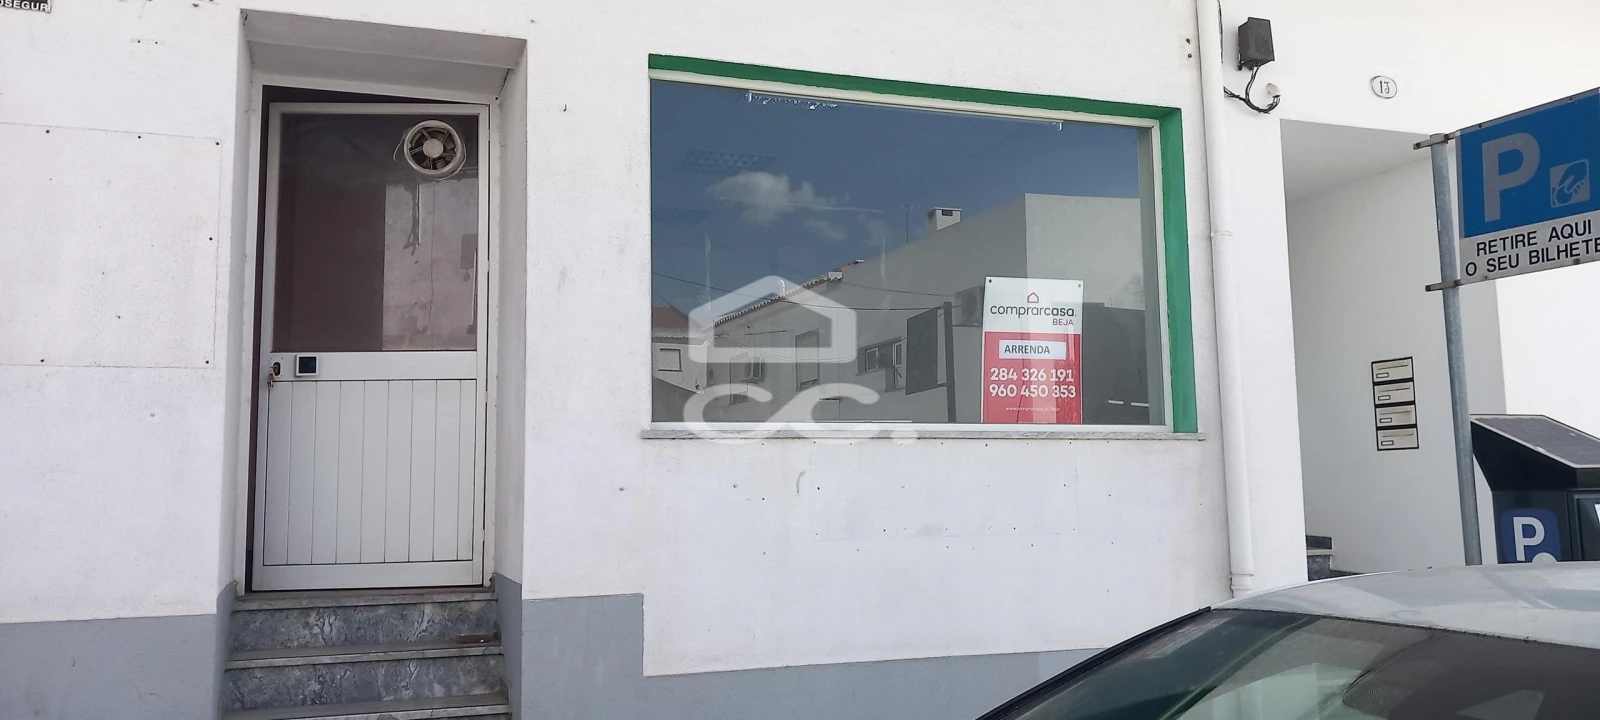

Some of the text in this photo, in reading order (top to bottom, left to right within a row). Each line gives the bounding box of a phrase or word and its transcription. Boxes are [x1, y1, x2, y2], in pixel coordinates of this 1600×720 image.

[1379, 80, 1390, 94] 13
[1482, 132, 1540, 222] P
[1476, 219, 1592, 257] RETIRE AQUI
[1465, 262, 1477, 276] O
[1486, 253, 1520, 273] SEU
[1052, 318, 1074, 326] BEJA
[1004, 344, 1050, 354] ARRENDA
[990, 367, 1074, 382] 284 326 191
[989, 384, 1076, 398] 960 450 353
[1513, 516, 1545, 562] P
